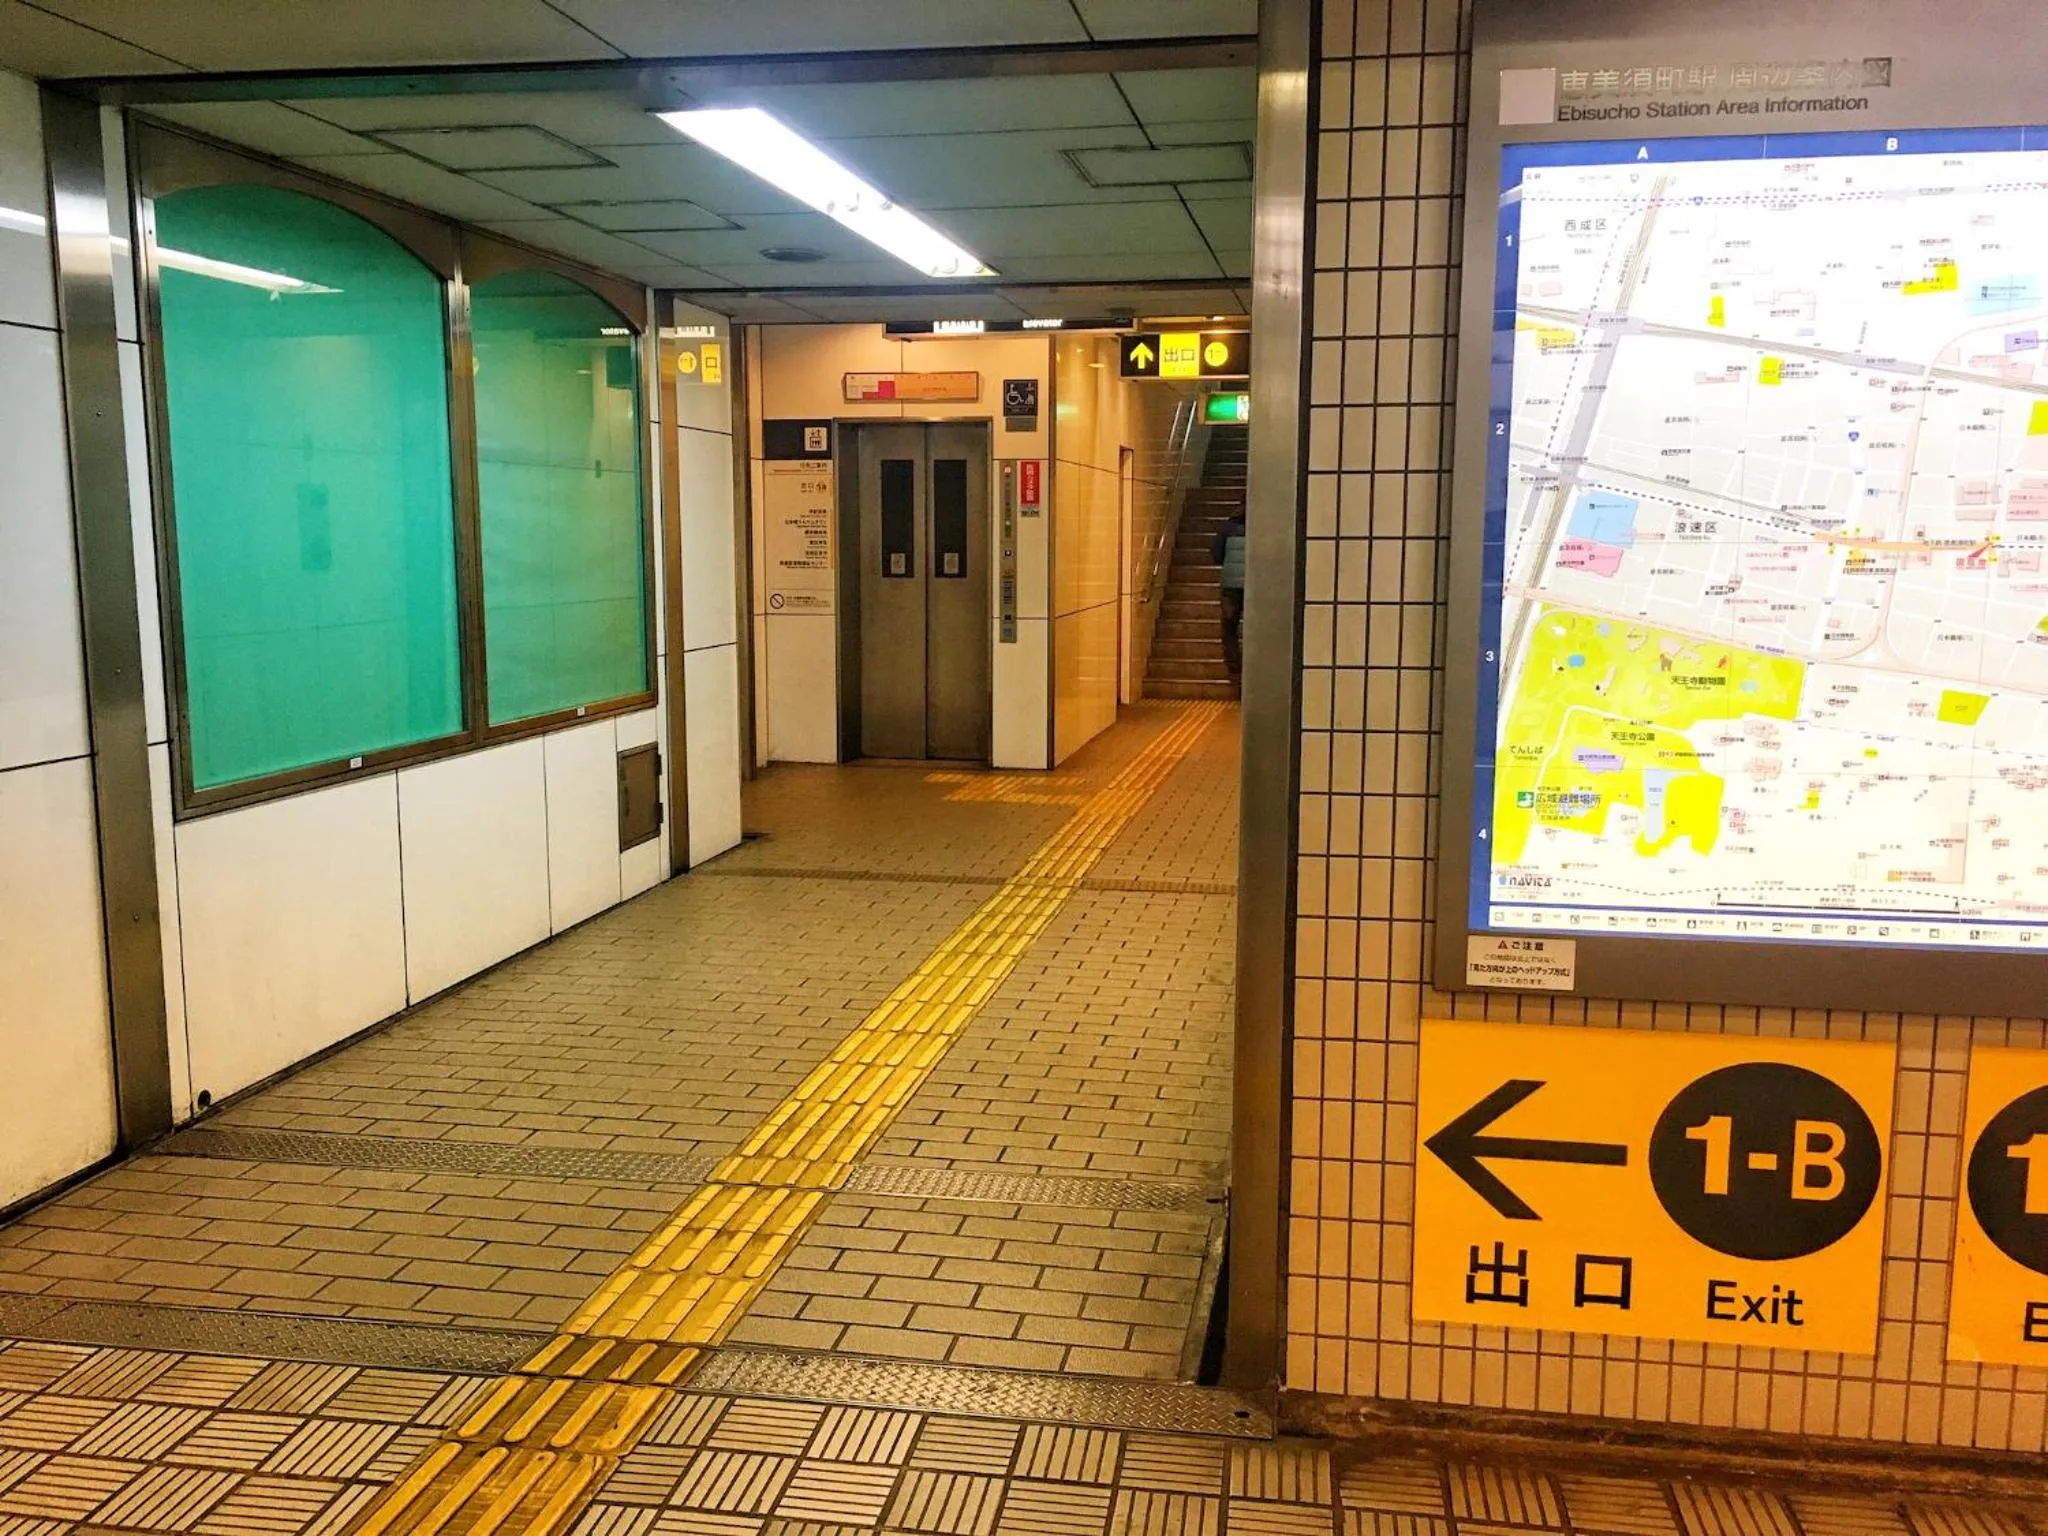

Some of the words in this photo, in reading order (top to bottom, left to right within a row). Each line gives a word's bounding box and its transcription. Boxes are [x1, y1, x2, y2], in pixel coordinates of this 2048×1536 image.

[1557, 103, 1641, 122] Ebisucho
[1646, 100, 1711, 118] Station
[1716, 98, 1760, 115] Area
[1764, 95, 1869, 113] Information
[1886, 137, 1898, 151] B
[1636, 146, 1649, 160] A
[1505, 235, 1512, 247] 1
[1163, 346, 1194, 363] 出口
[1496, 423, 1505, 436] 2
[1486, 650, 1495, 662] 3
[1478, 828, 1487, 839] 4
[1685, 1114, 1848, 1202] 1-B
[1465, 1240, 1633, 1311] 出口
[1705, 1279, 1806, 1328] Exit
